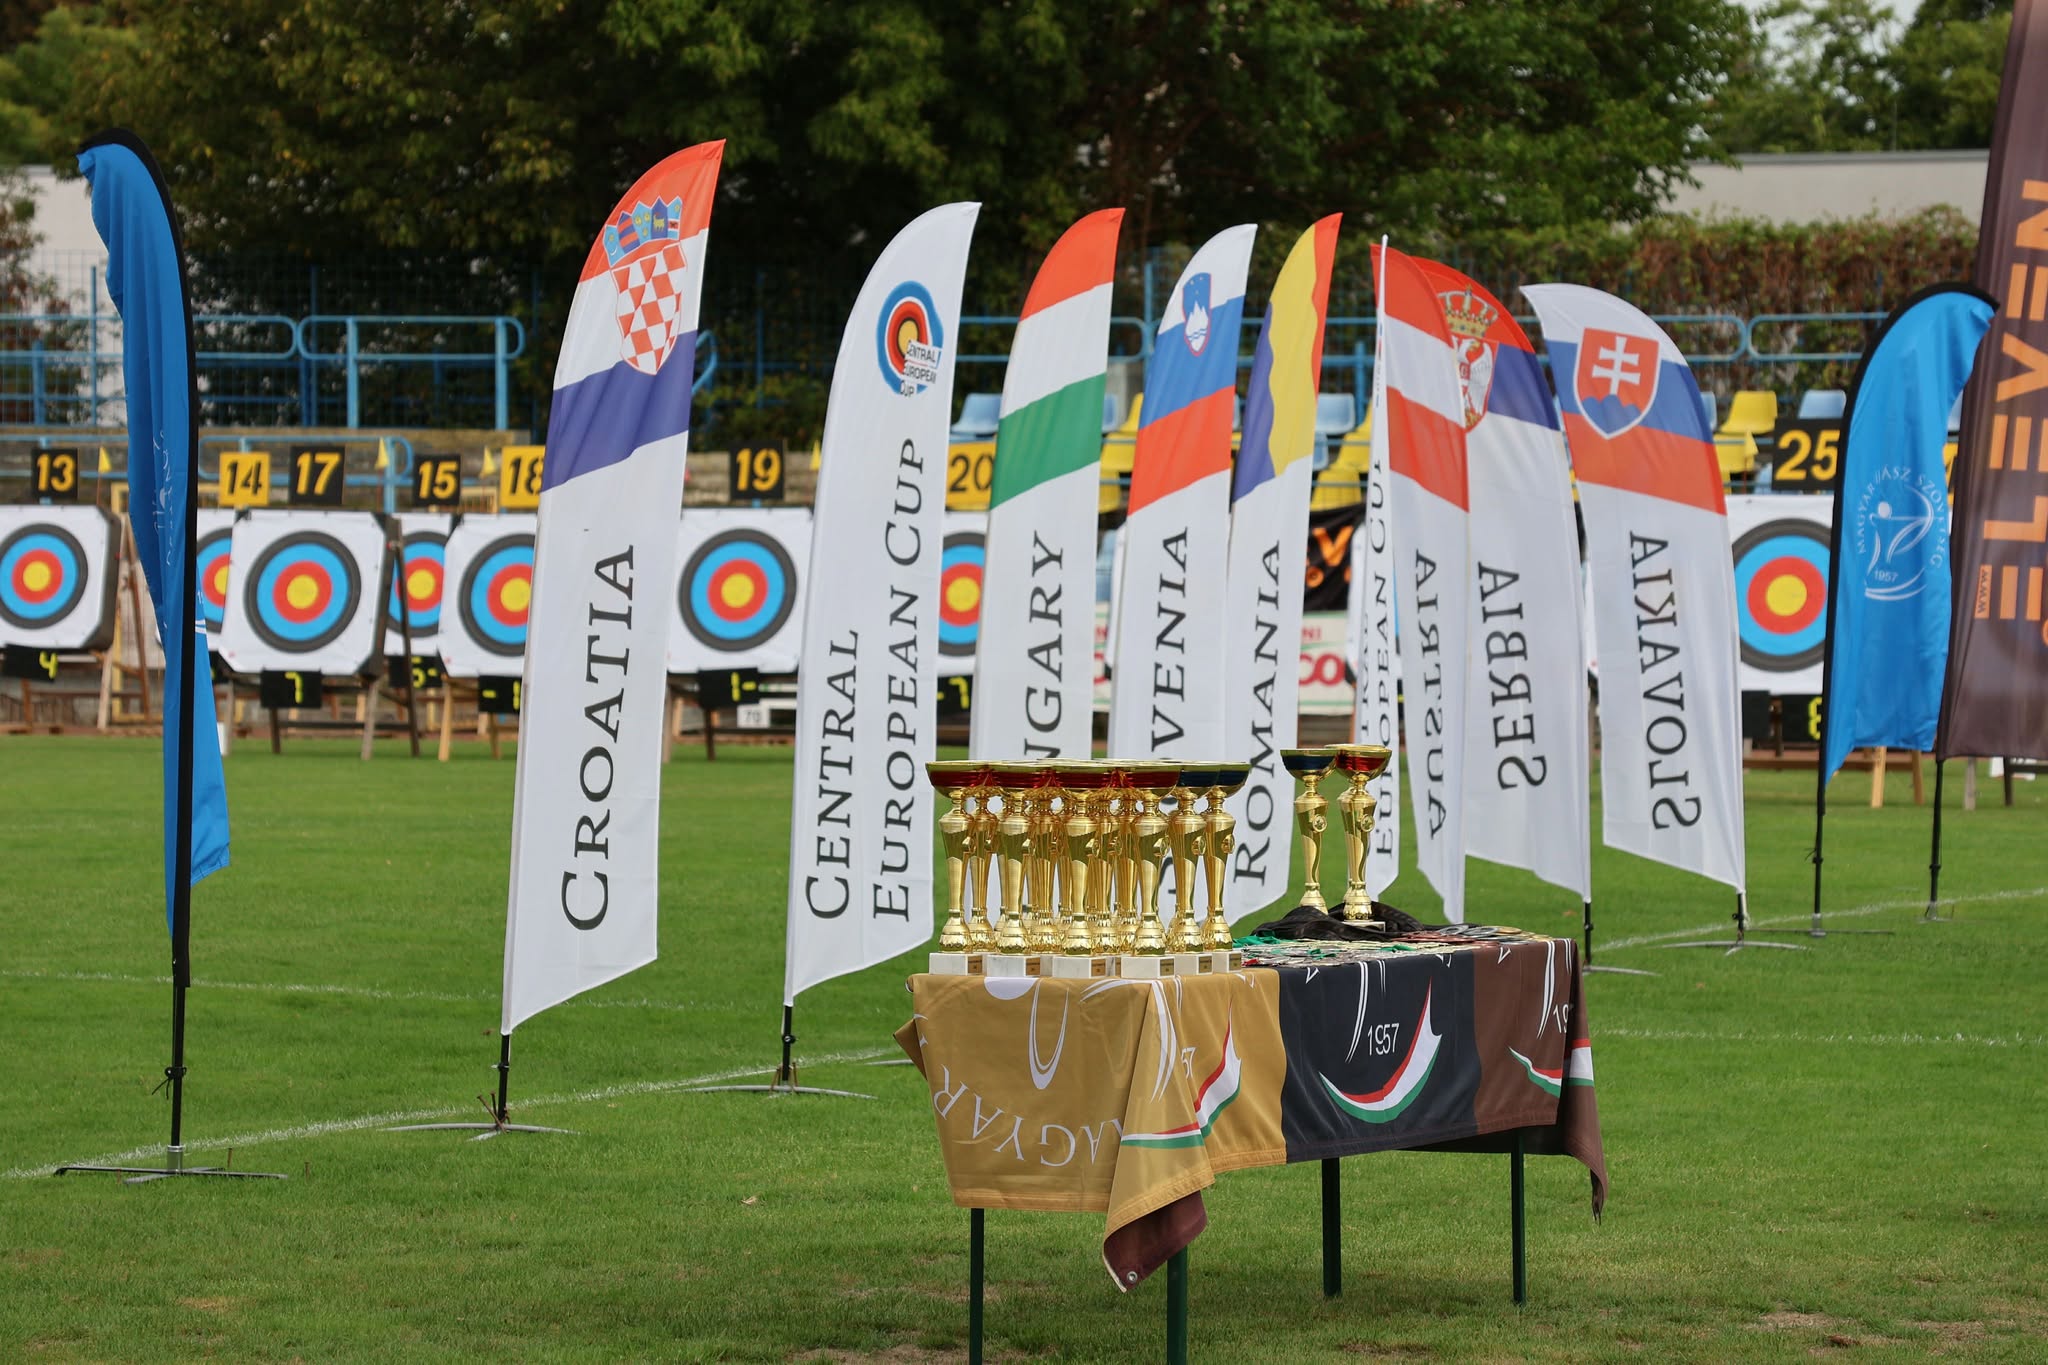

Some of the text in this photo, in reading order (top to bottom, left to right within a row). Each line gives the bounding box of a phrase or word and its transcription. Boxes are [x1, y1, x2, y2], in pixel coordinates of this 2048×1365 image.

[36, 453, 76, 492] 13
[296, 451, 342, 495] 17
[736, 448, 782, 492] 19
[949, 454, 994, 493] 20
[1774, 429, 1840, 482] 25
[226, 458, 264, 497] 14
[417, 460, 458, 498] 15
[507, 457, 543, 496] 18
[1874, 569, 1899, 583] 1957
[1024, 530, 1064, 758] GARY
[1370, 460, 1394, 859] EUOPEAN CU
[39, 650, 58, 679] 4
[872, 438, 924, 922] EUROPEAN CUP
[284, 670, 302, 704] 7
[1233, 540, 1280, 886] ROMANIA
[561, 544, 635, 931] CROATIA
[805, 629, 859, 920] CENTRAL
[1552, 1003, 1570, 1034] 19
[1367, 1022, 1401, 1057] 1957
[1180, 1046, 1197, 1079] 57
[933, 1063, 1123, 1167] AGYAR
